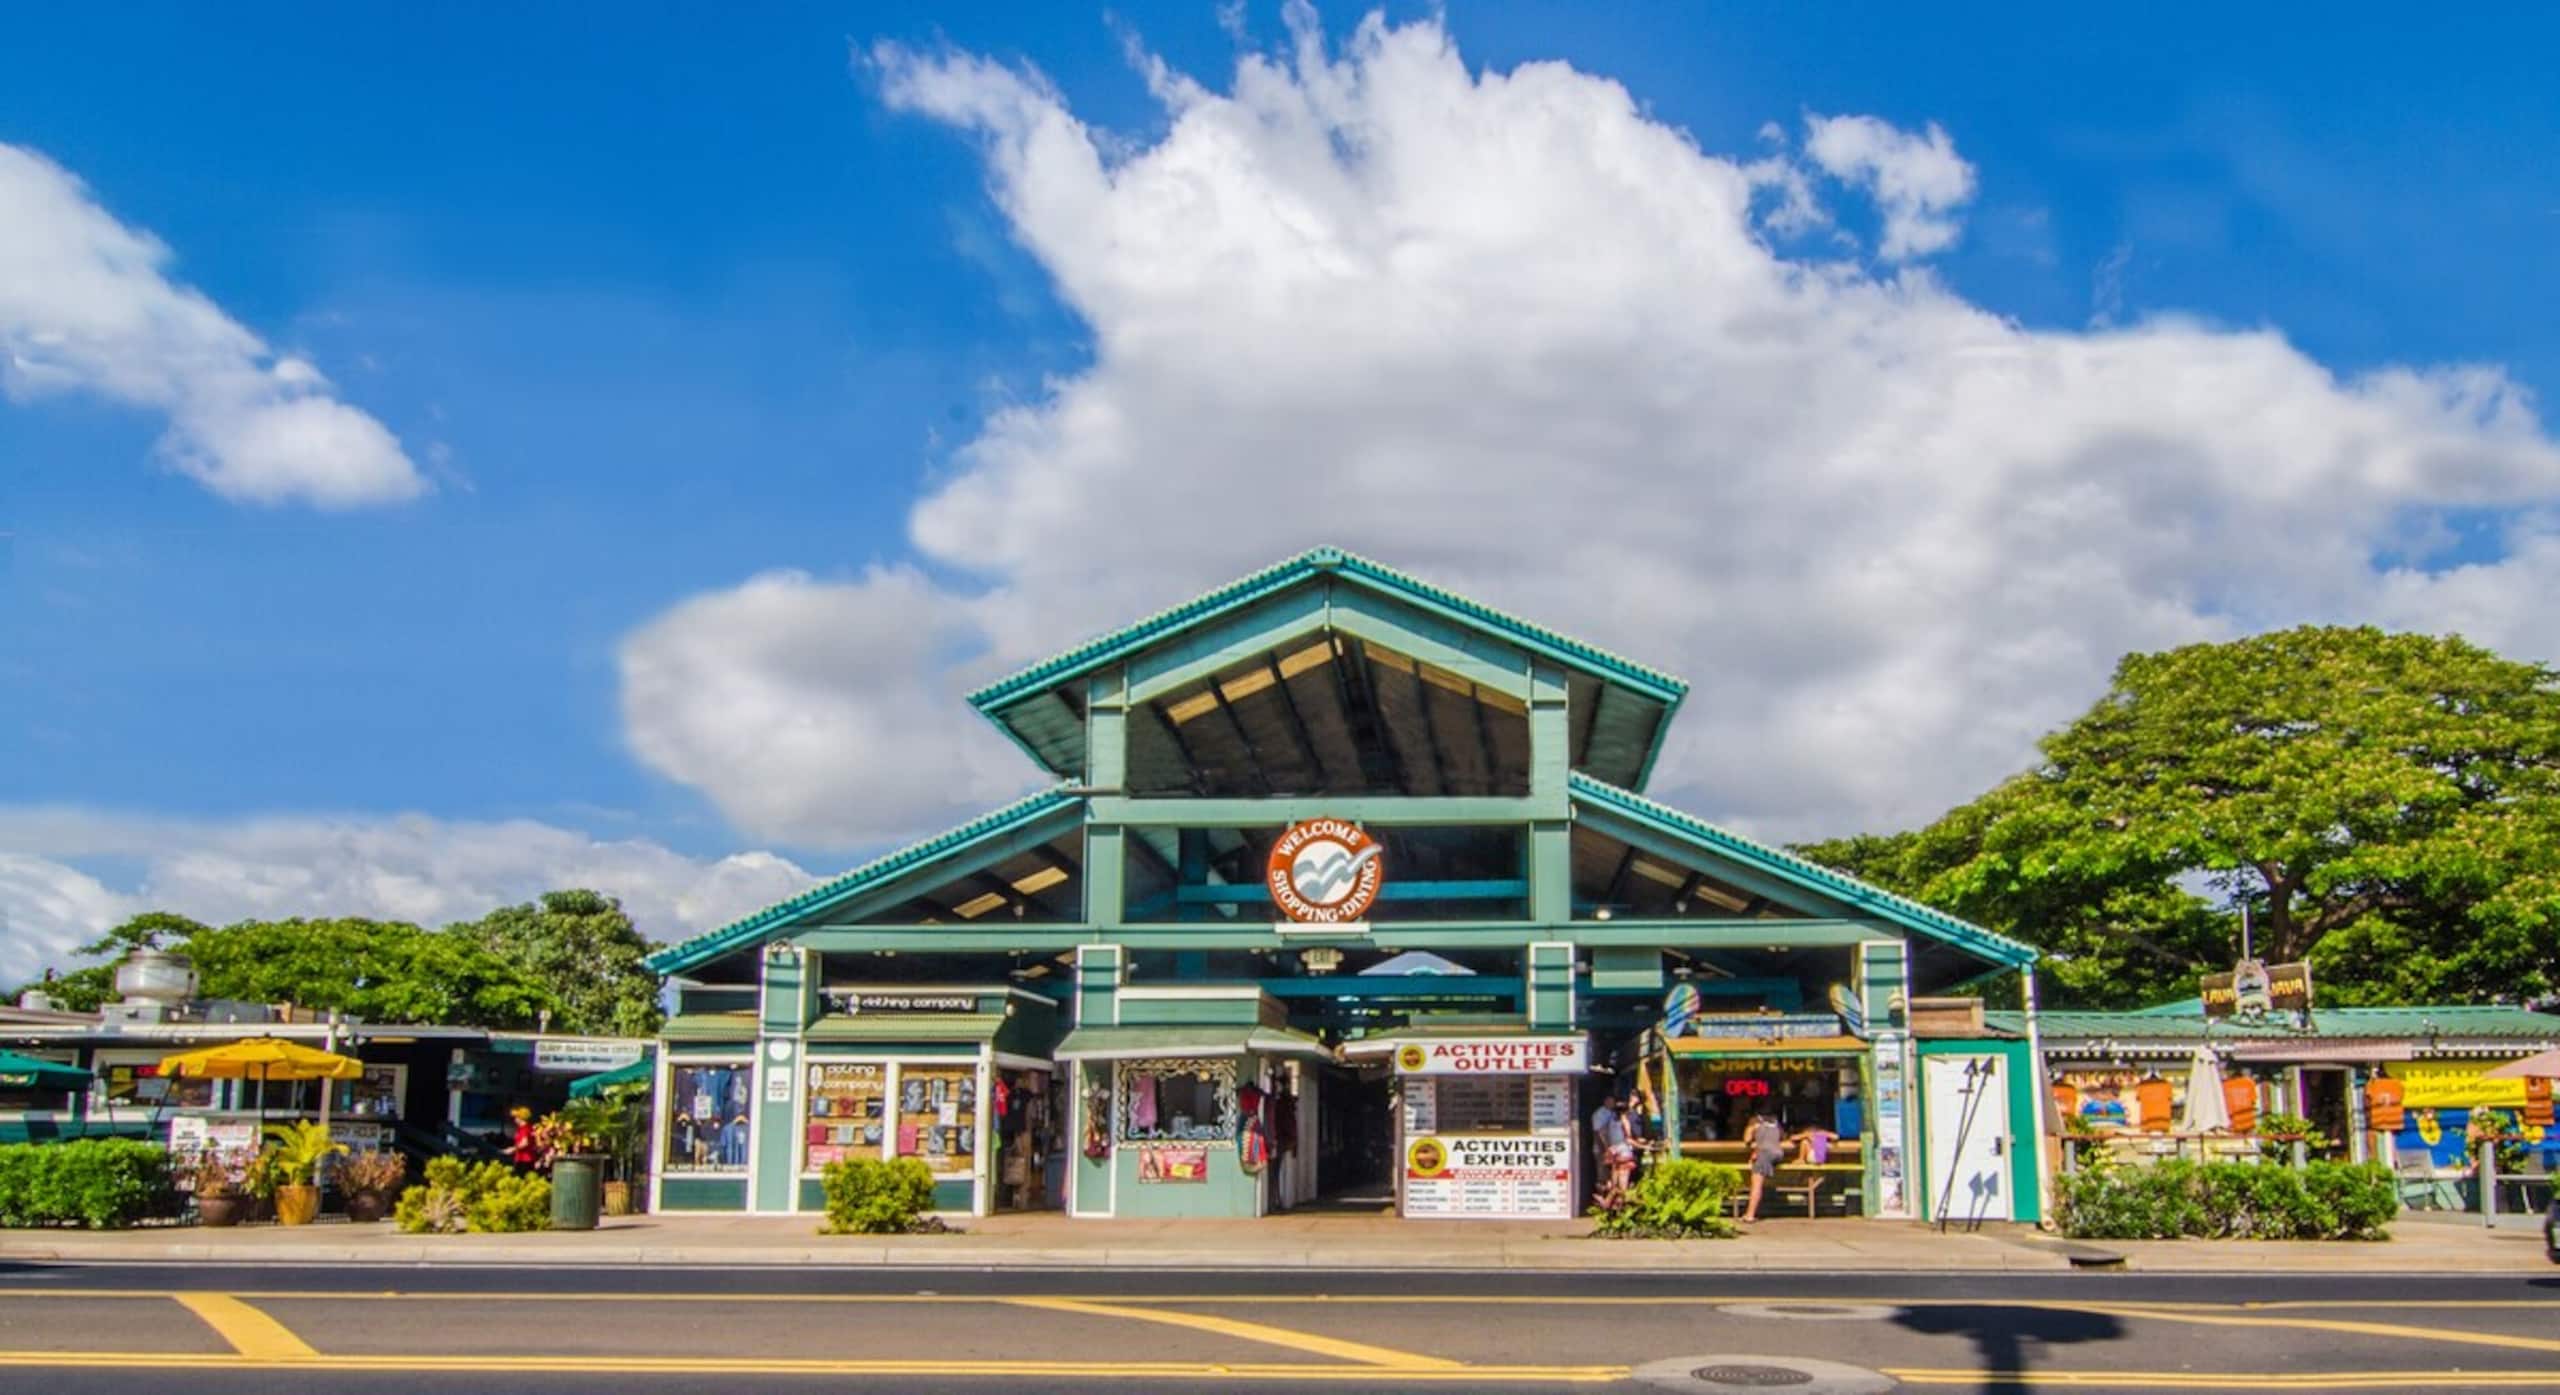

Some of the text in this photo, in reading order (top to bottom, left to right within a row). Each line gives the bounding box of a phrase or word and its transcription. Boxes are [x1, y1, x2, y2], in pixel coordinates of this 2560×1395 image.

[1278, 821, 1361, 856] WELCOME
[1272, 869, 1339, 922] SHOPPING
[912, 997, 973, 1010] company
[1434, 1043, 1574, 1056] ACTIVITIES
[1455, 1058, 1553, 1070] OUTLET
[1726, 1080, 1769, 1095] OPEN
[1453, 1140, 1566, 1152] ACTIVITIES
[1464, 1154, 1555, 1166] EXPERTS
